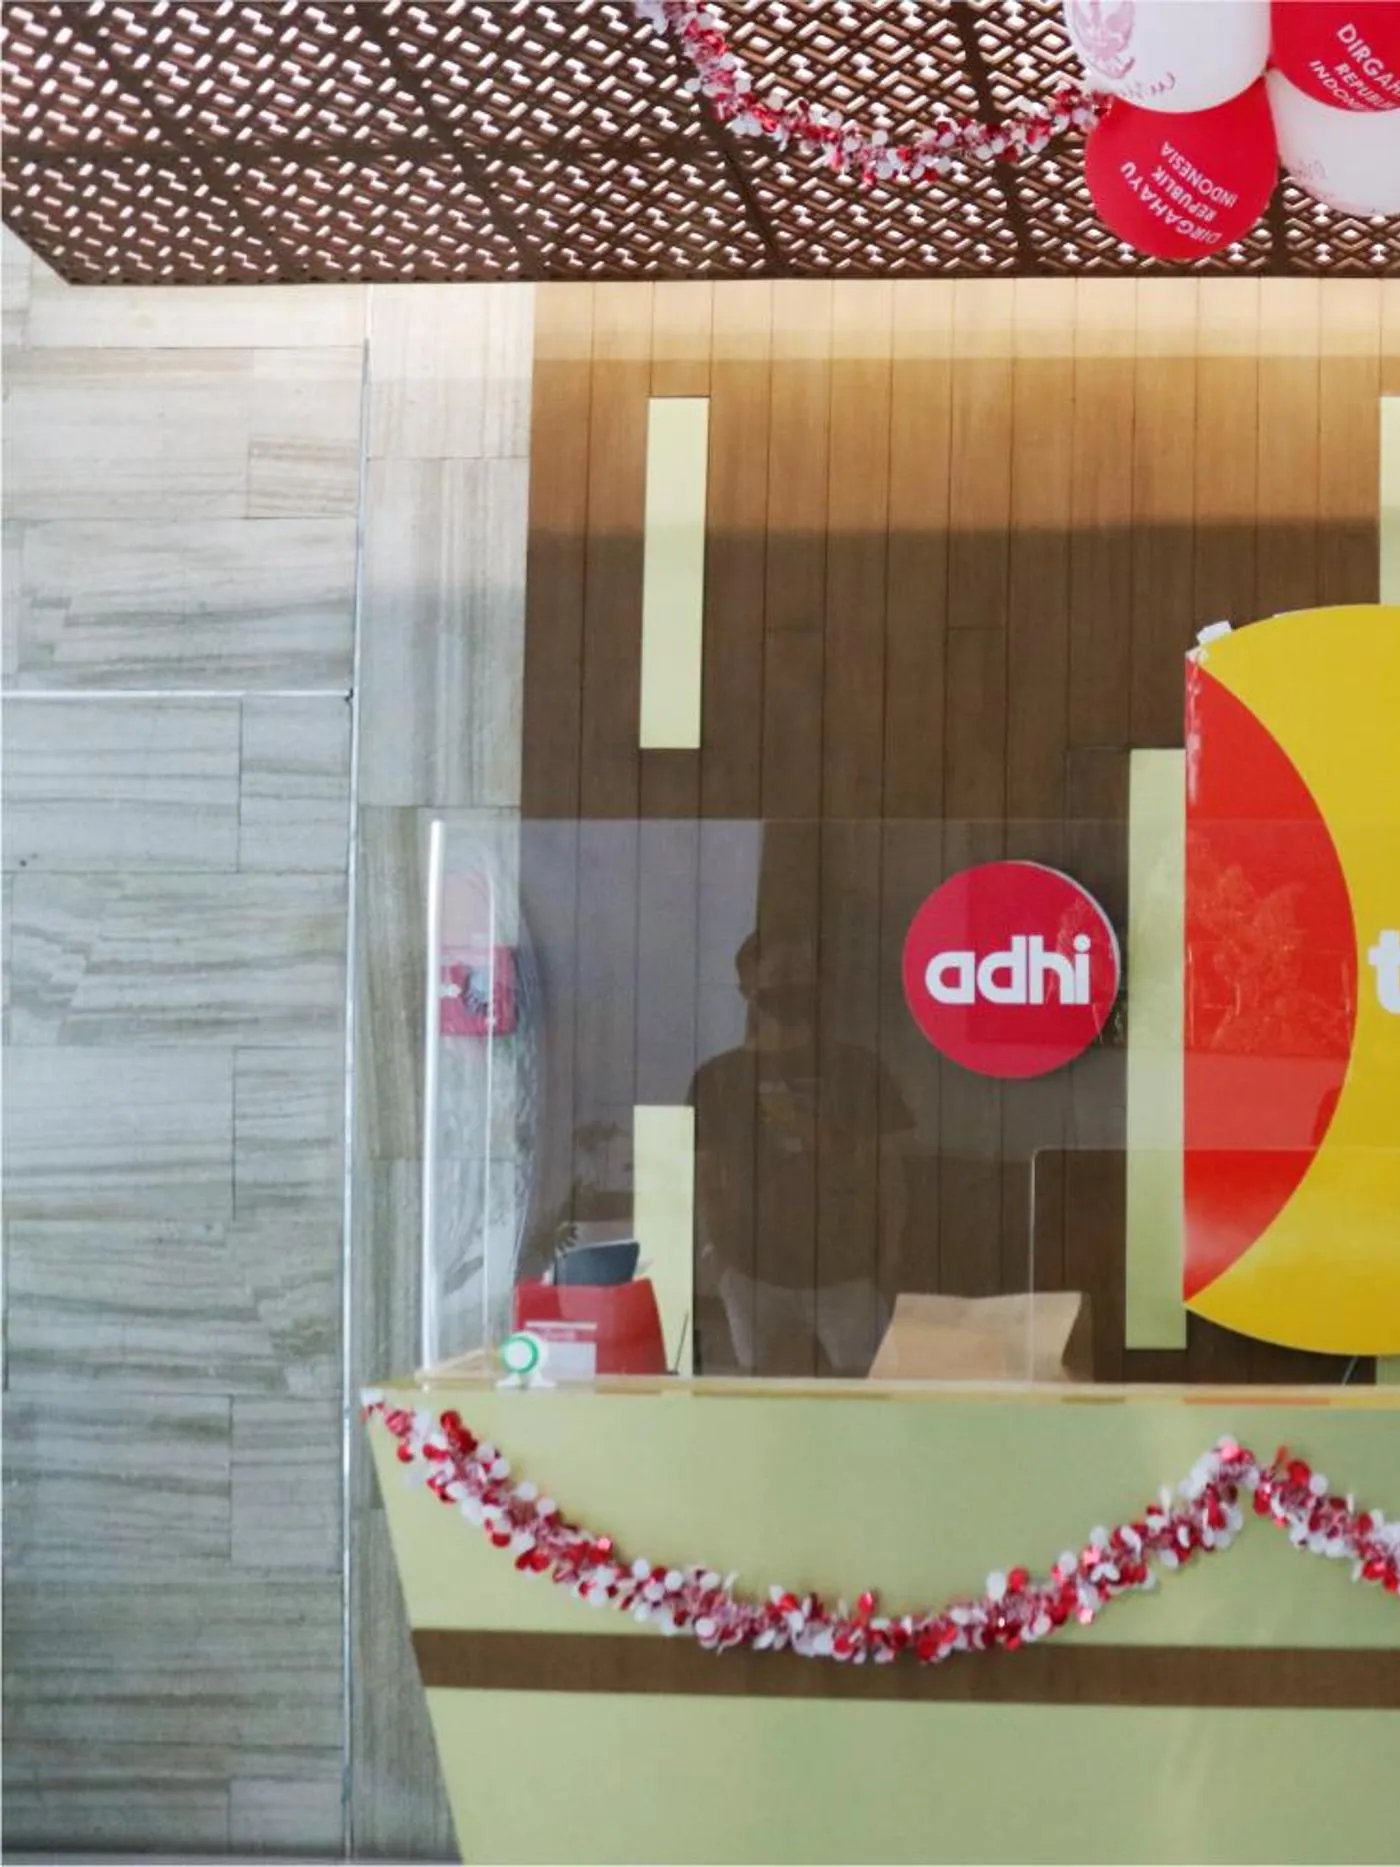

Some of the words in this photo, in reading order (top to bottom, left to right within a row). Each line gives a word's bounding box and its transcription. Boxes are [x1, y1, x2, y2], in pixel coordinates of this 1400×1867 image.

[1120, 161, 1222, 244] DIRGAHAYU
[1151, 165, 1217, 222] REPUBLIK
[1160, 141, 1238, 208] INDONESIA
[925, 934, 1091, 1005] adhi
